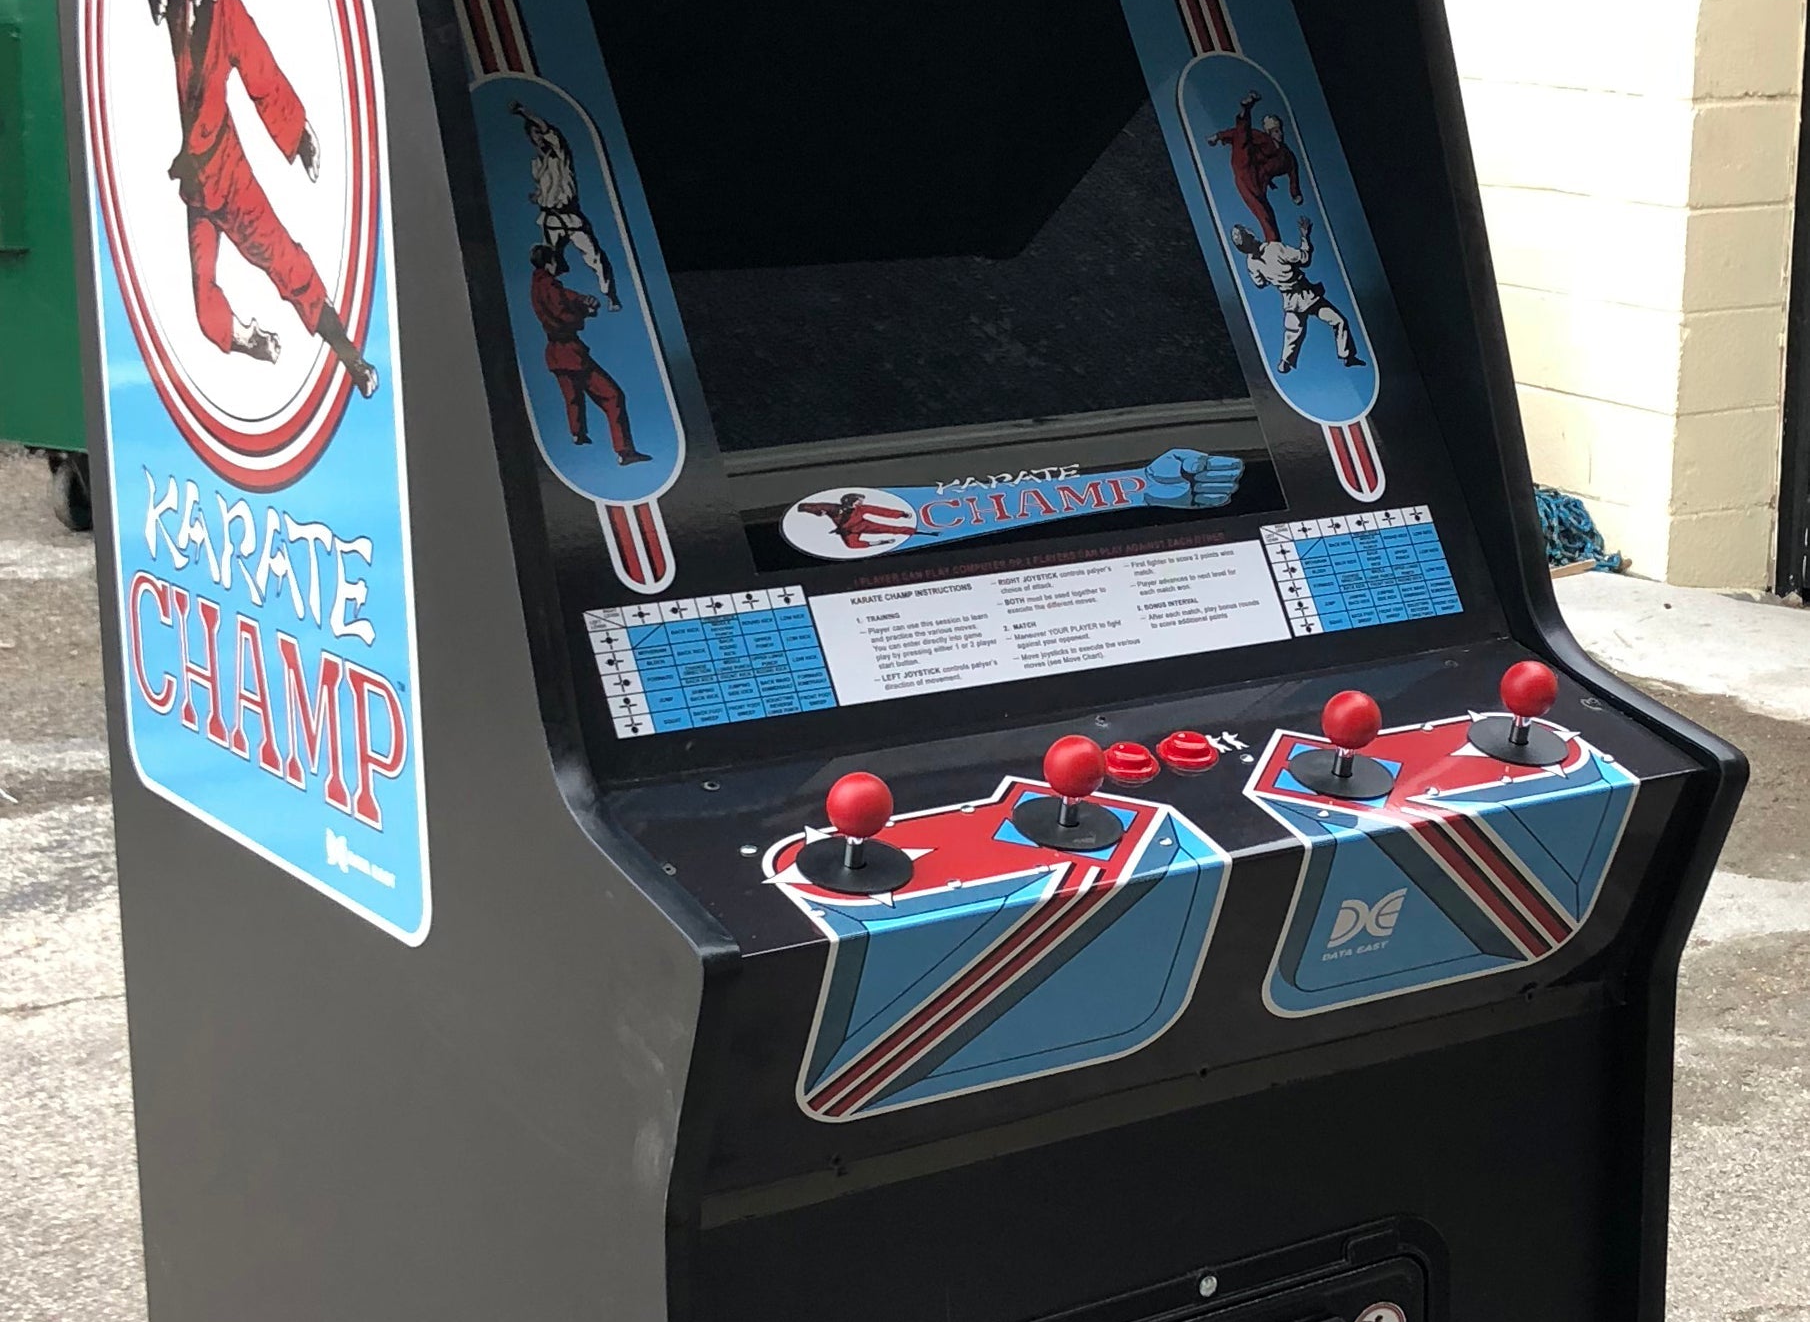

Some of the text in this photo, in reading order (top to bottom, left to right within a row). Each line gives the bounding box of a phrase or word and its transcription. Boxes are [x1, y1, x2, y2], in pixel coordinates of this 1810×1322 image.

[935, 463, 1081, 495] KARATE
[918, 476, 1148, 529] CHAMP
[144, 465, 377, 646] KARATE
[998, 577, 1021, 586] RIGHT
[1022, 572, 1058, 583] JOYSTICK
[850, 583, 973, 605] KARATE CHAMP INSTRUCTIONS
[1004, 597, 1025, 605] BOTH
[1071, 587, 1099, 598] together
[1046, 599, 1074, 609] different
[1144, 602, 1167, 610] BONUS
[1168, 597, 1199, 607] INTERVAL
[866, 613, 901, 622] TRAINING
[867, 625, 891, 636] Player
[935, 617, 961, 626] session
[1013, 622, 1037, 630] MATCH
[1048, 627, 1069, 636] YOUR
[1070, 623, 1098, 633] PLAYER
[885, 632, 914, 643] practice
[914, 630, 926, 638] the
[928, 627, 953, 636] various
[902, 640, 921, 648] enter
[922, 636, 948, 647] directly
[963, 633, 983, 641] game
[875, 653, 891, 662] play
[902, 648, 933, 659] pressing
[1021, 652, 1040, 661] Move
[1046, 658, 1062, 667] (see
[1063, 655, 1081, 664] Move
[878, 662, 895, 670] start
[881, 673, 902, 682] LEFT
[903, 667, 941, 679] JOYSTICK
[942, 663, 970, 673] controls
[884, 680, 915, 691] direction
[128, 570, 409, 832] CHAMP
[1322, 940, 1389, 962] DATA EAST
